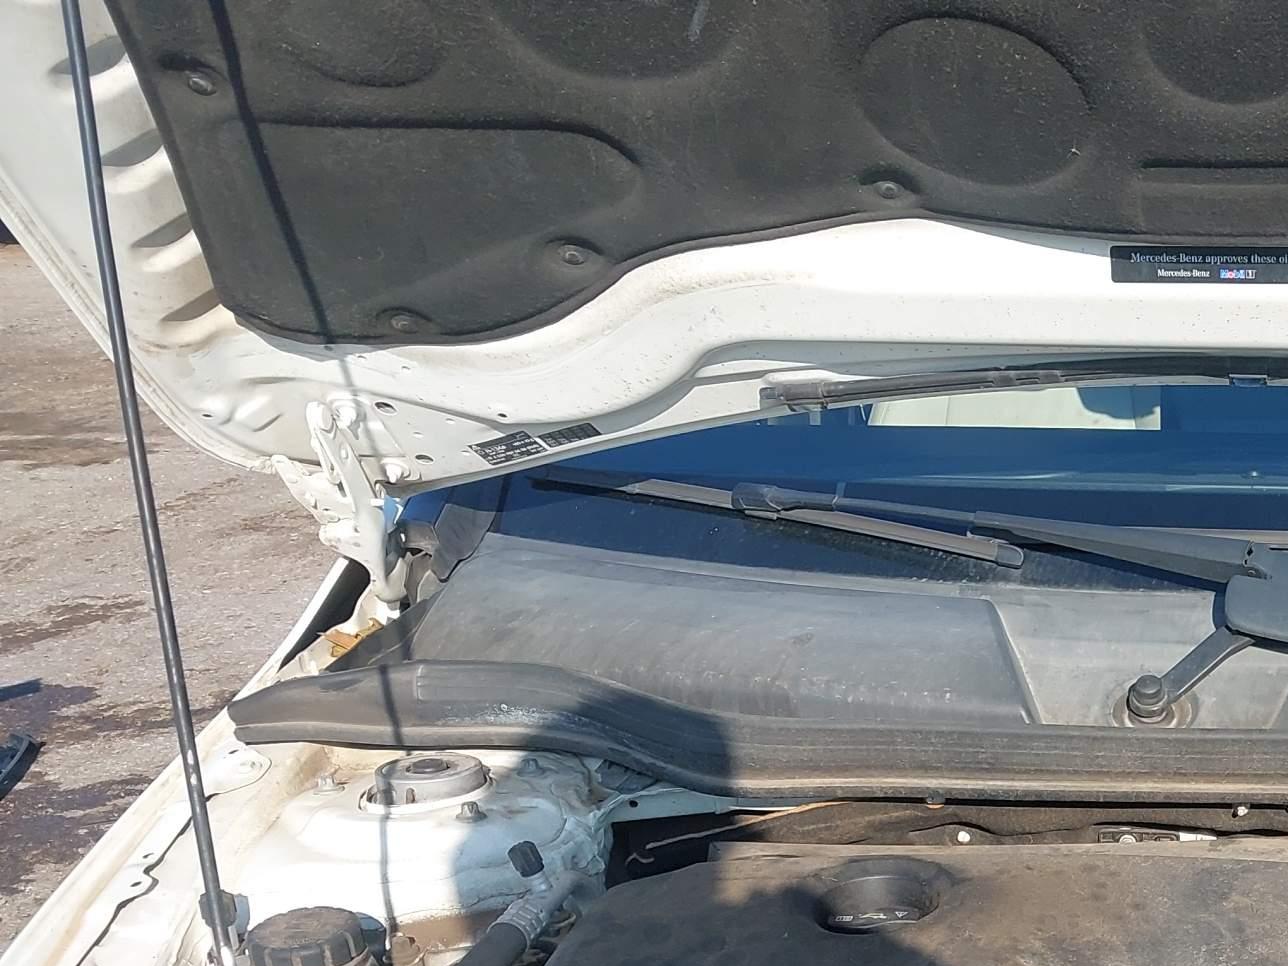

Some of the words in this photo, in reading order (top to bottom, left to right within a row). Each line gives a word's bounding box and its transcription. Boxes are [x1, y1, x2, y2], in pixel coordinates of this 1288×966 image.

[1130, 252, 1203, 263] Mercedes-Benz
[1205, 253, 1248, 265] approves
[1250, 253, 1277, 263] these
[1157, 269, 1210, 277] Mercedes-Benz
